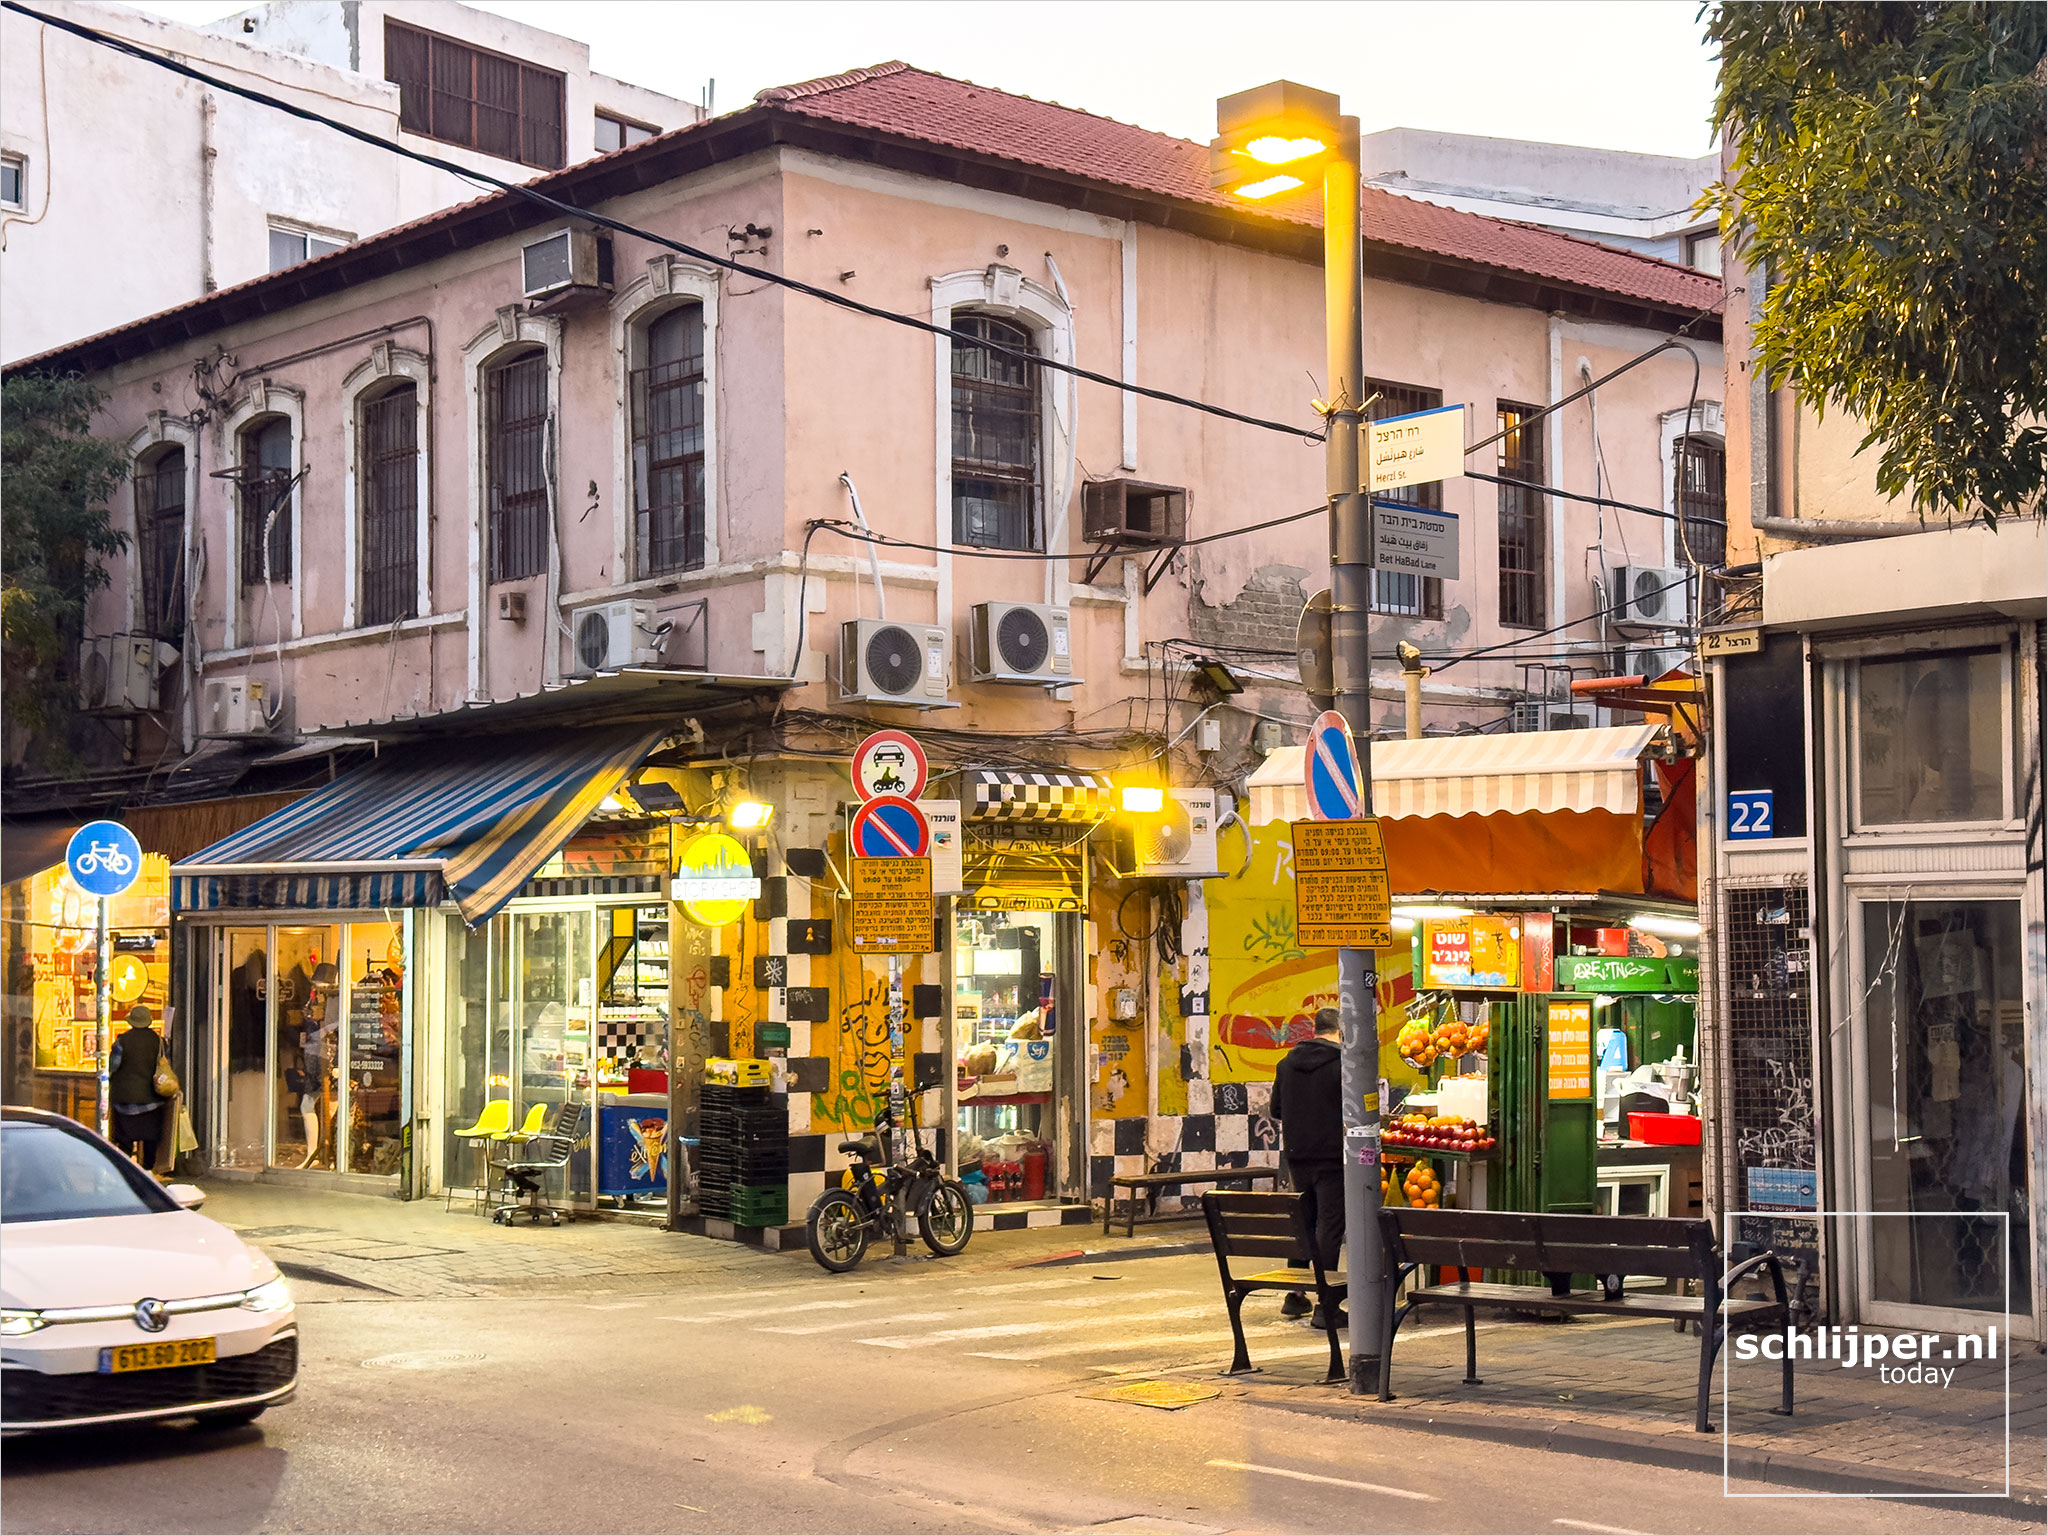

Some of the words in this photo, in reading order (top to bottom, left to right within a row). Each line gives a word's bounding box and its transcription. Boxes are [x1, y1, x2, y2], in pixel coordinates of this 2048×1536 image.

[1376, 428, 1403, 443] הרצל
[1376, 471, 1396, 484] Herzl
[1379, 513, 1399, 526] הבד
[1401, 516, 1418, 529] בית
[1379, 553, 1393, 565] Bet
[1395, 555, 1420, 569] HaBad
[1709, 635, 1721, 649] 22
[1726, 636, 1751, 648] הרצל
[1731, 801, 1771, 834] 22
[674, 881, 719, 898] STORY
[721, 880, 758, 898] SHOP
[1436, 933, 1466, 945] שוט
[1432, 950, 1470, 962] גינג'ר
